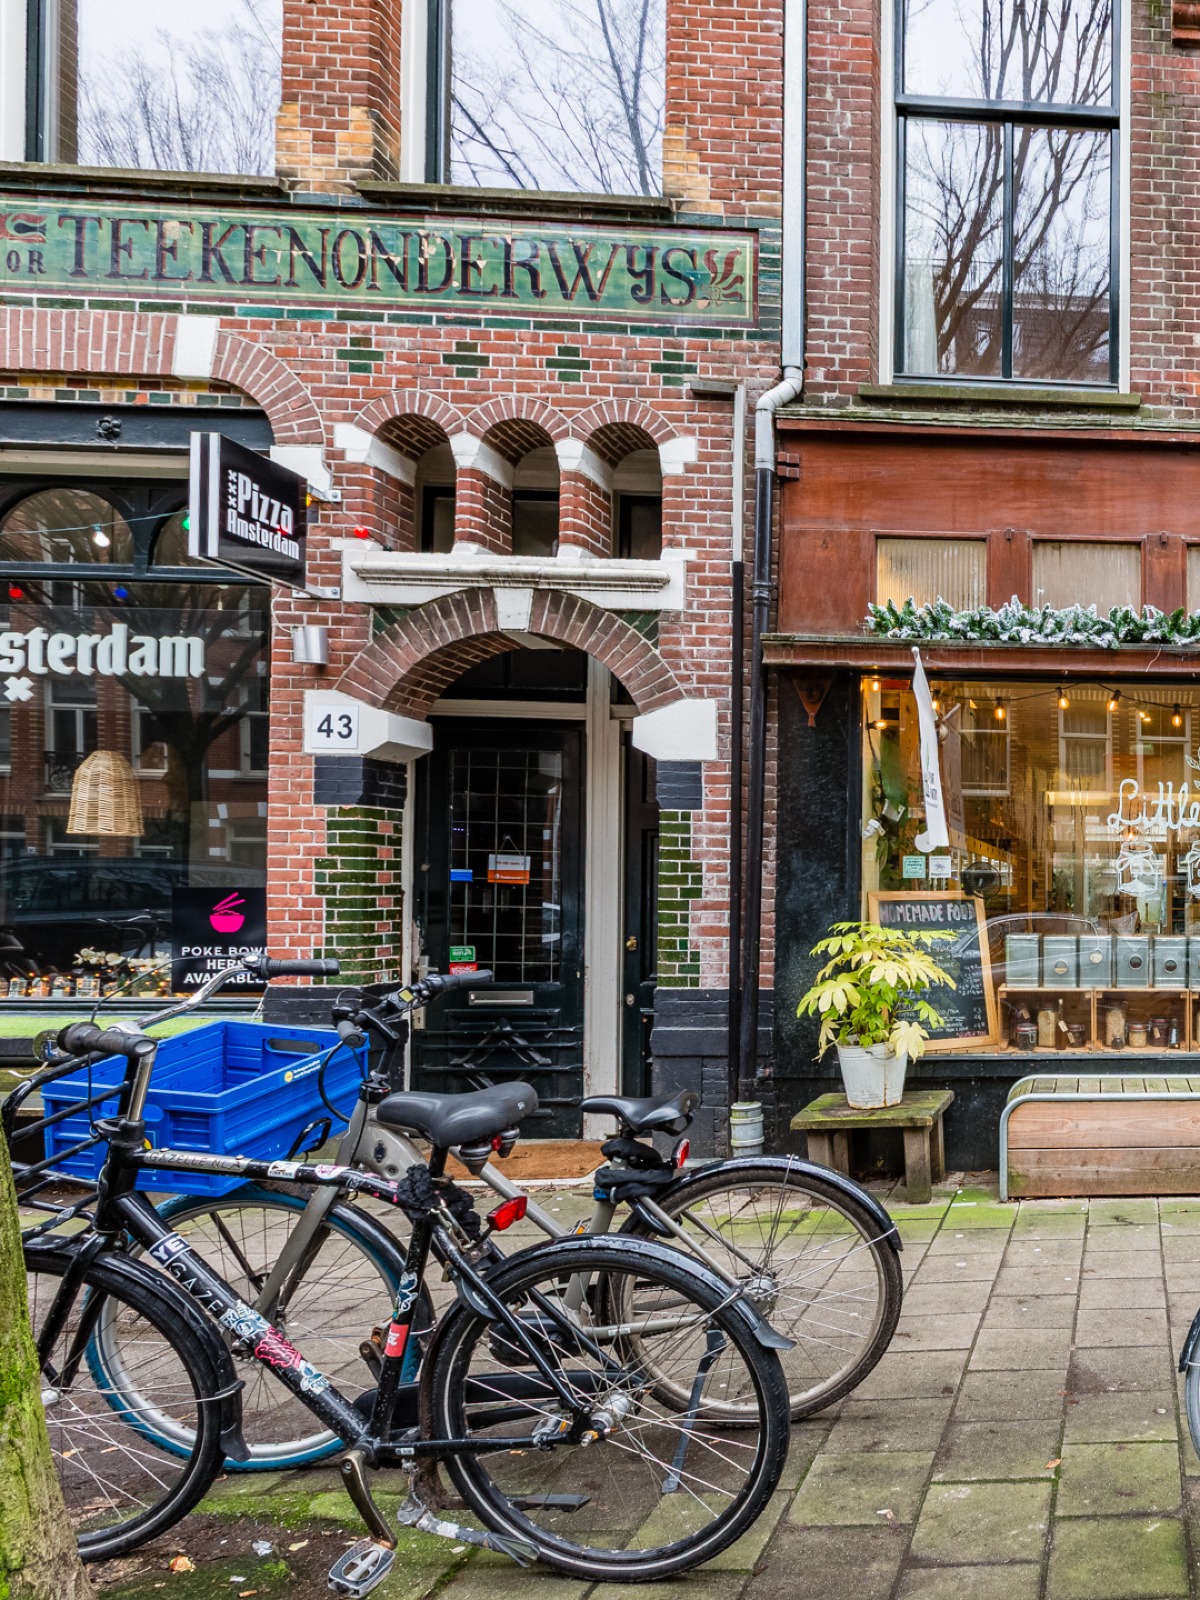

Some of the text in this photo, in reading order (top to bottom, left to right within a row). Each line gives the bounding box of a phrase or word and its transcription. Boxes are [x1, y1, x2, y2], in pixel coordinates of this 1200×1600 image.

[237, 472, 294, 535] Pizza
[227, 508, 299, 560] Amsterdam
[0, 623, 206, 678] sterdam
[317, 713, 353, 739] 43
[880, 902, 976, 922] HOMEMADE FOOD
[181, 946, 222, 957] POKE
[149, 1151, 207, 1166] GAZELLE
